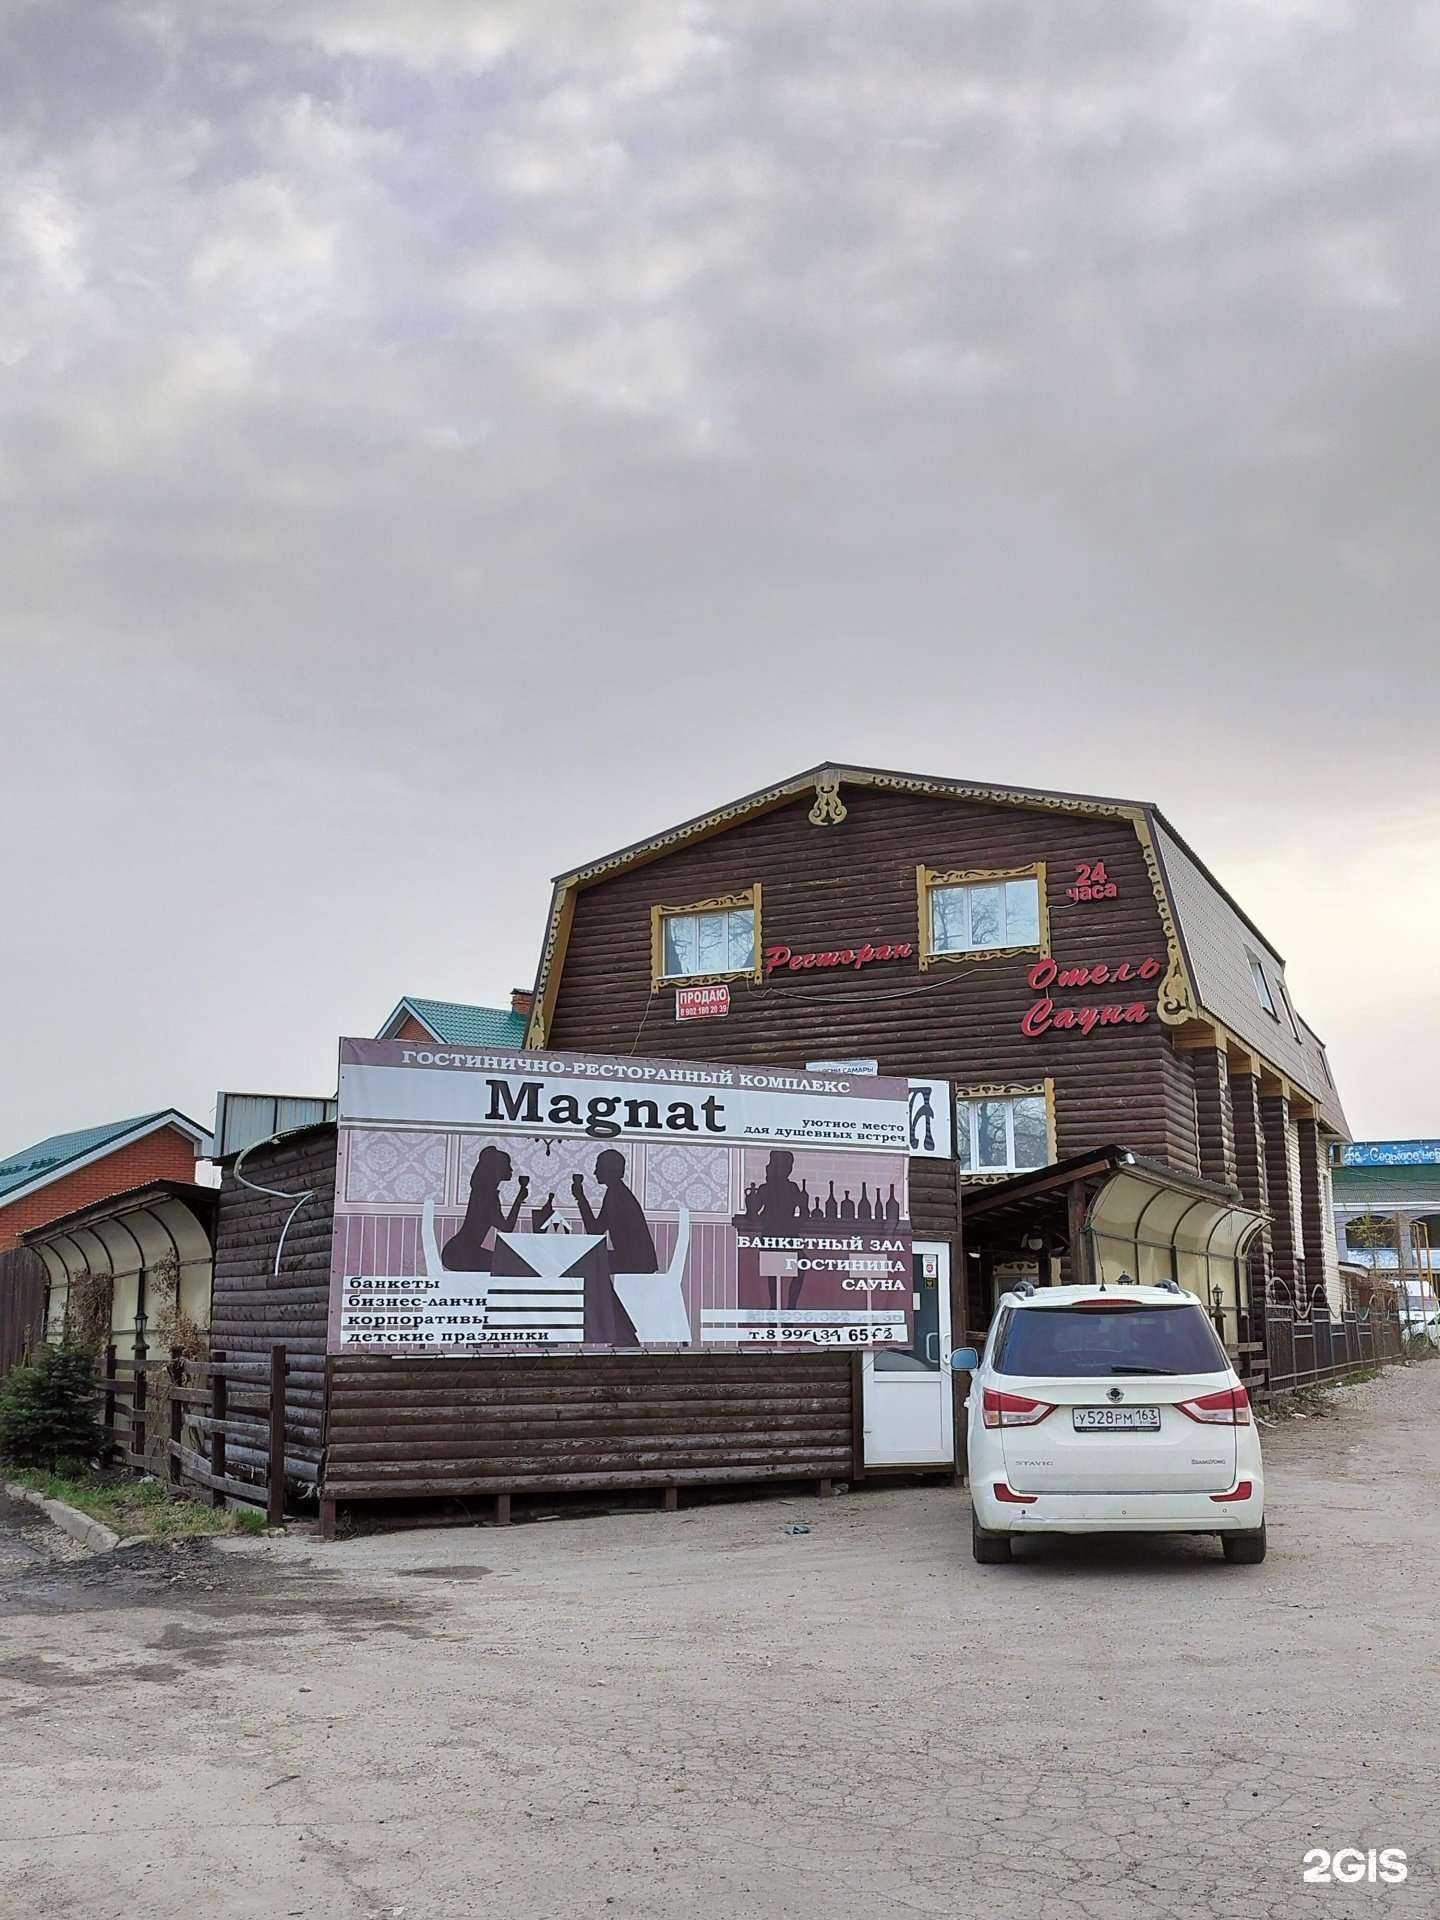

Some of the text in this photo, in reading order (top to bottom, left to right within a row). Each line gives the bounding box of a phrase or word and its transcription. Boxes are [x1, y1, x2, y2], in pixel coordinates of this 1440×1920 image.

[1074, 861, 1108, 886] 24
[1065, 882, 1118, 901] часа
[765, 942, 913, 974] Ресторан
[1028, 957, 1161, 990] Отель
[680, 988, 727, 1004] ПРОДАЮ
[1021, 998, 1150, 1037] Сауна
[401, 1050, 851, 1093] ГОСТИНИЧНО-РЕСТОРАННЫЙ КОМПЛЕКС
[484, 1079, 727, 1138] Magnat
[802, 1118, 905, 1133] уютное место
[744, 1125, 906, 1143] для душевных встреч
[737, 1235, 905, 1252] БАНКЕТНЫЙ ЗАЛ
[785, 1258, 906, 1273] ГОСТИНИЦА
[349, 1276, 441, 1289] банкеты
[841, 1278, 907, 1291] САУНА
[348, 1294, 488, 1308] бизнес-ланчи
[347, 1314, 489, 1327] корпоративы
[347, 1330, 549, 1344] детские праздники
[1135, 1409, 1157, 1421] 163
